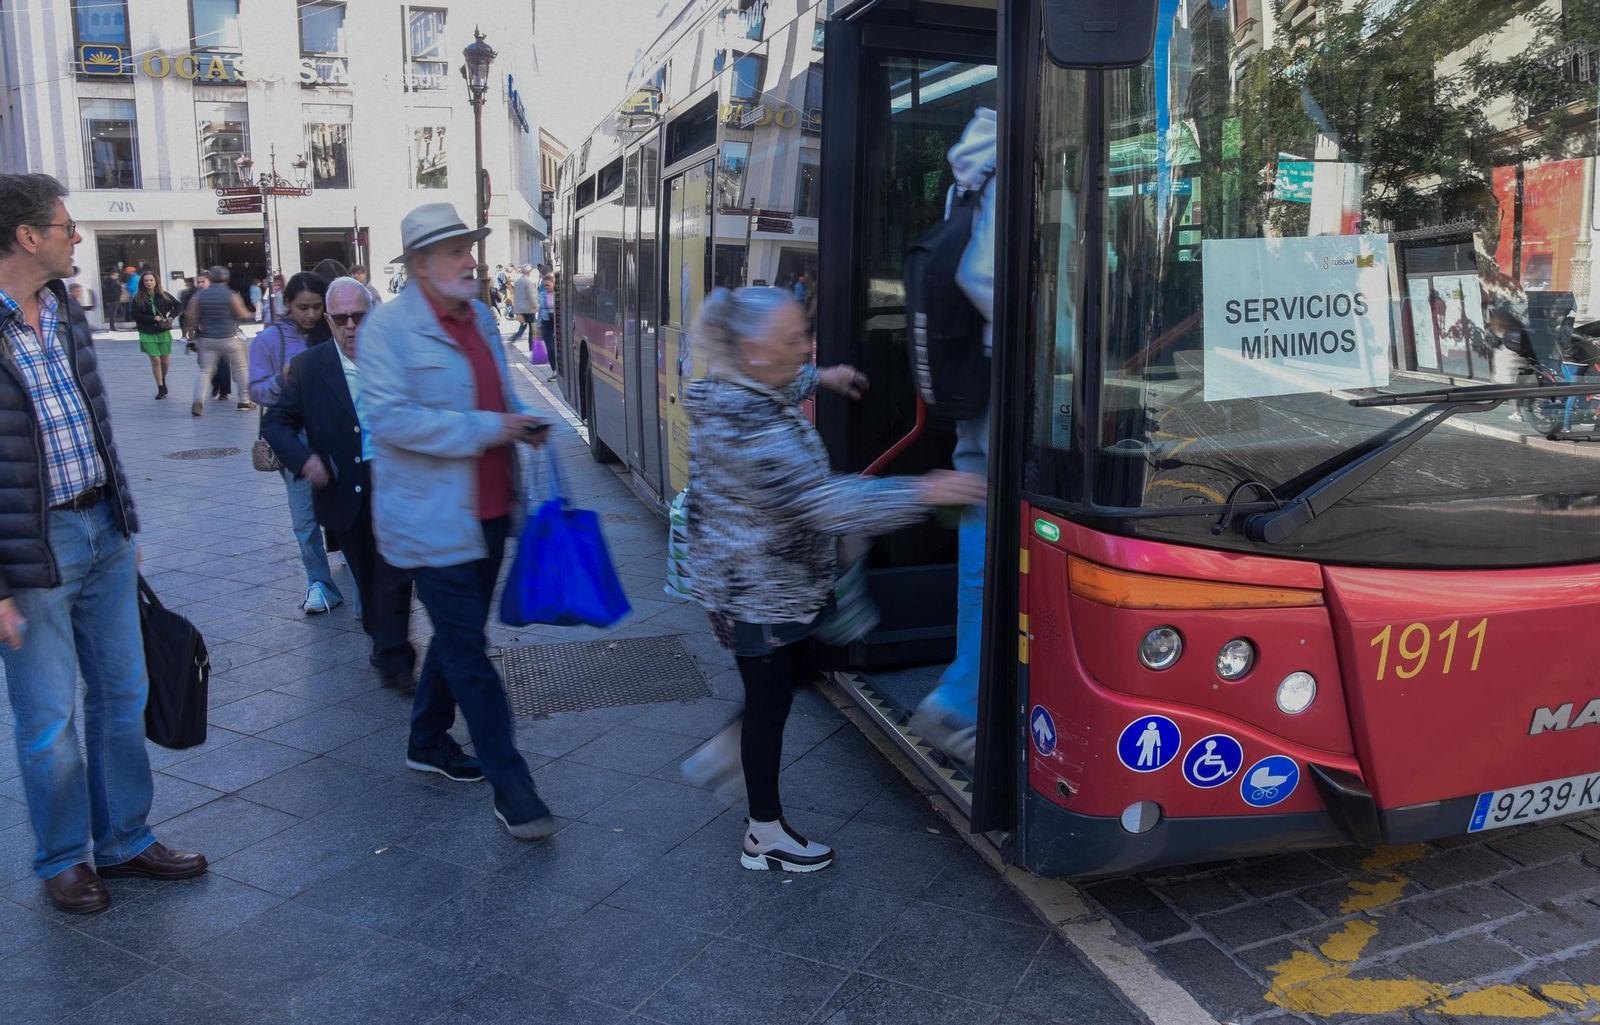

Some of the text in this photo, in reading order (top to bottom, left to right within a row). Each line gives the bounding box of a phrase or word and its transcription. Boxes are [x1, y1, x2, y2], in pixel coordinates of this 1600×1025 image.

[1331, 258, 1355, 266] TUSSAM
[1225, 292, 1369, 324] SERVICIOS
[1241, 328, 1356, 360] MÍNIMOS
[1370, 618, 1488, 681] 1911
[1494, 776, 1600, 823] 9239 K
[1474, 814, 1484, 825] E
